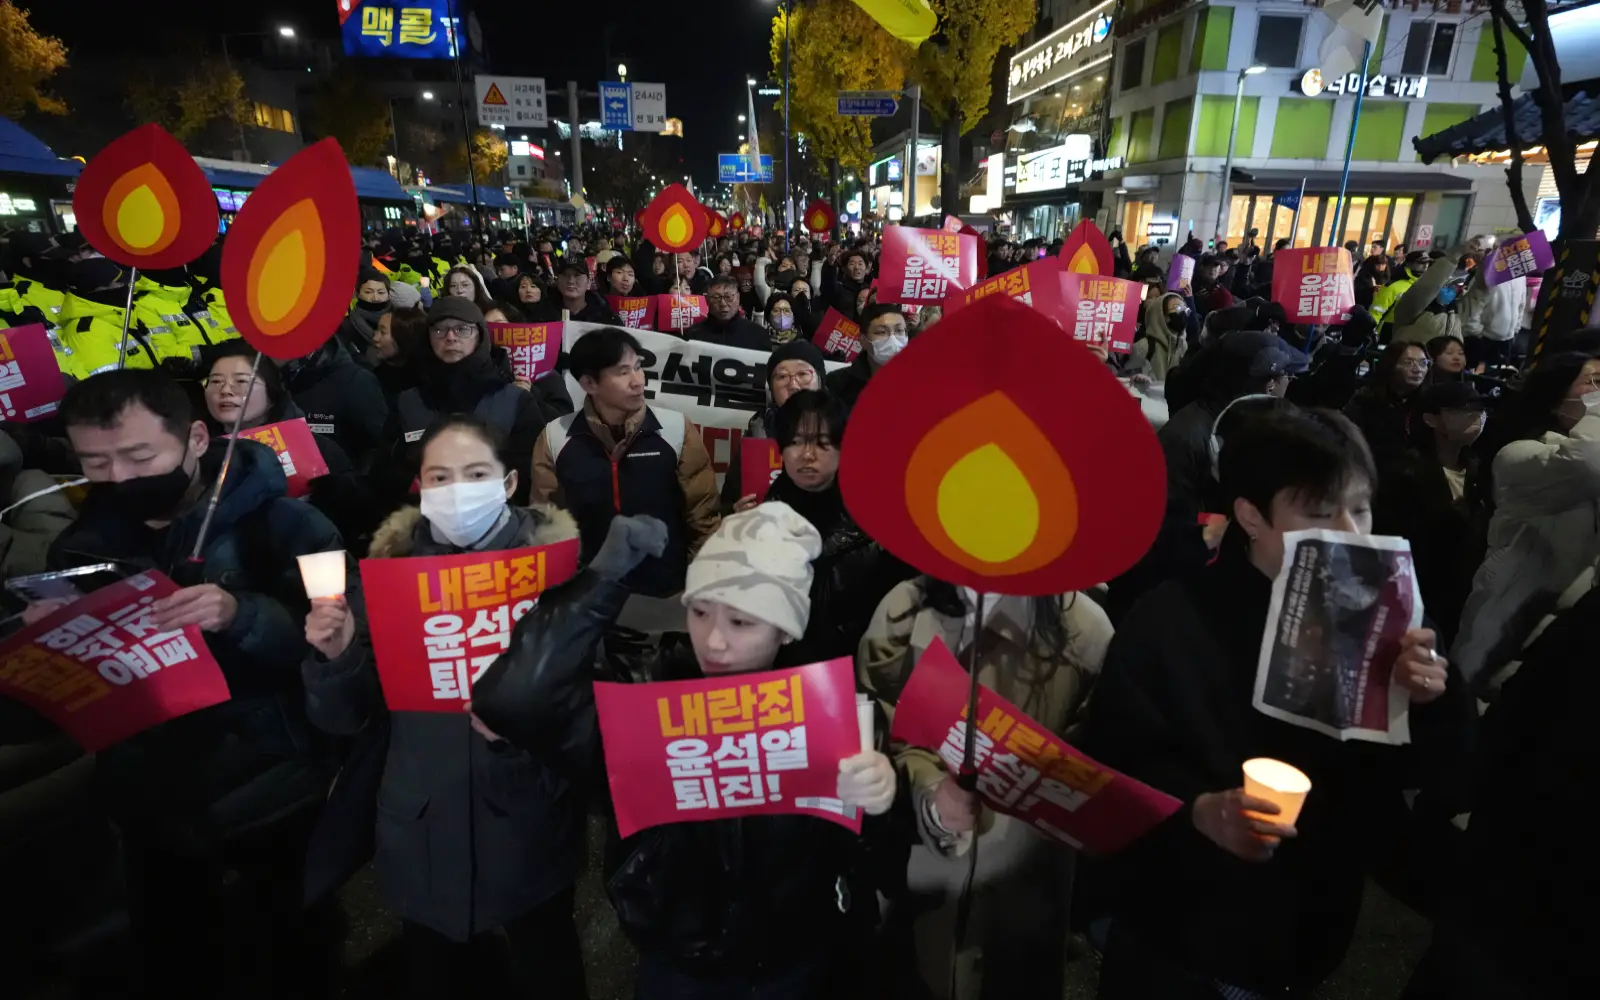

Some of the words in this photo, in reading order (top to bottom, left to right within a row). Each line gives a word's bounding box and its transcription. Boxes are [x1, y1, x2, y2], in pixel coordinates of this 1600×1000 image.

[361, 7, 437, 47] 맥콜
[634, 91, 663, 101] 24시간
[900, 279, 948, 299] 퇴진!
[1080, 280, 1128, 302] 내란죄
[1076, 300, 1125, 323] 윤석열
[1296, 296, 1341, 317] 퇴진!
[493, 325, 547, 347] 내란죄
[417, 552, 547, 613] 내란죄
[656, 673, 806, 737] 내란죄
[665, 725, 809, 778] 윤석열
[672, 773, 783, 811] 퇴진!
